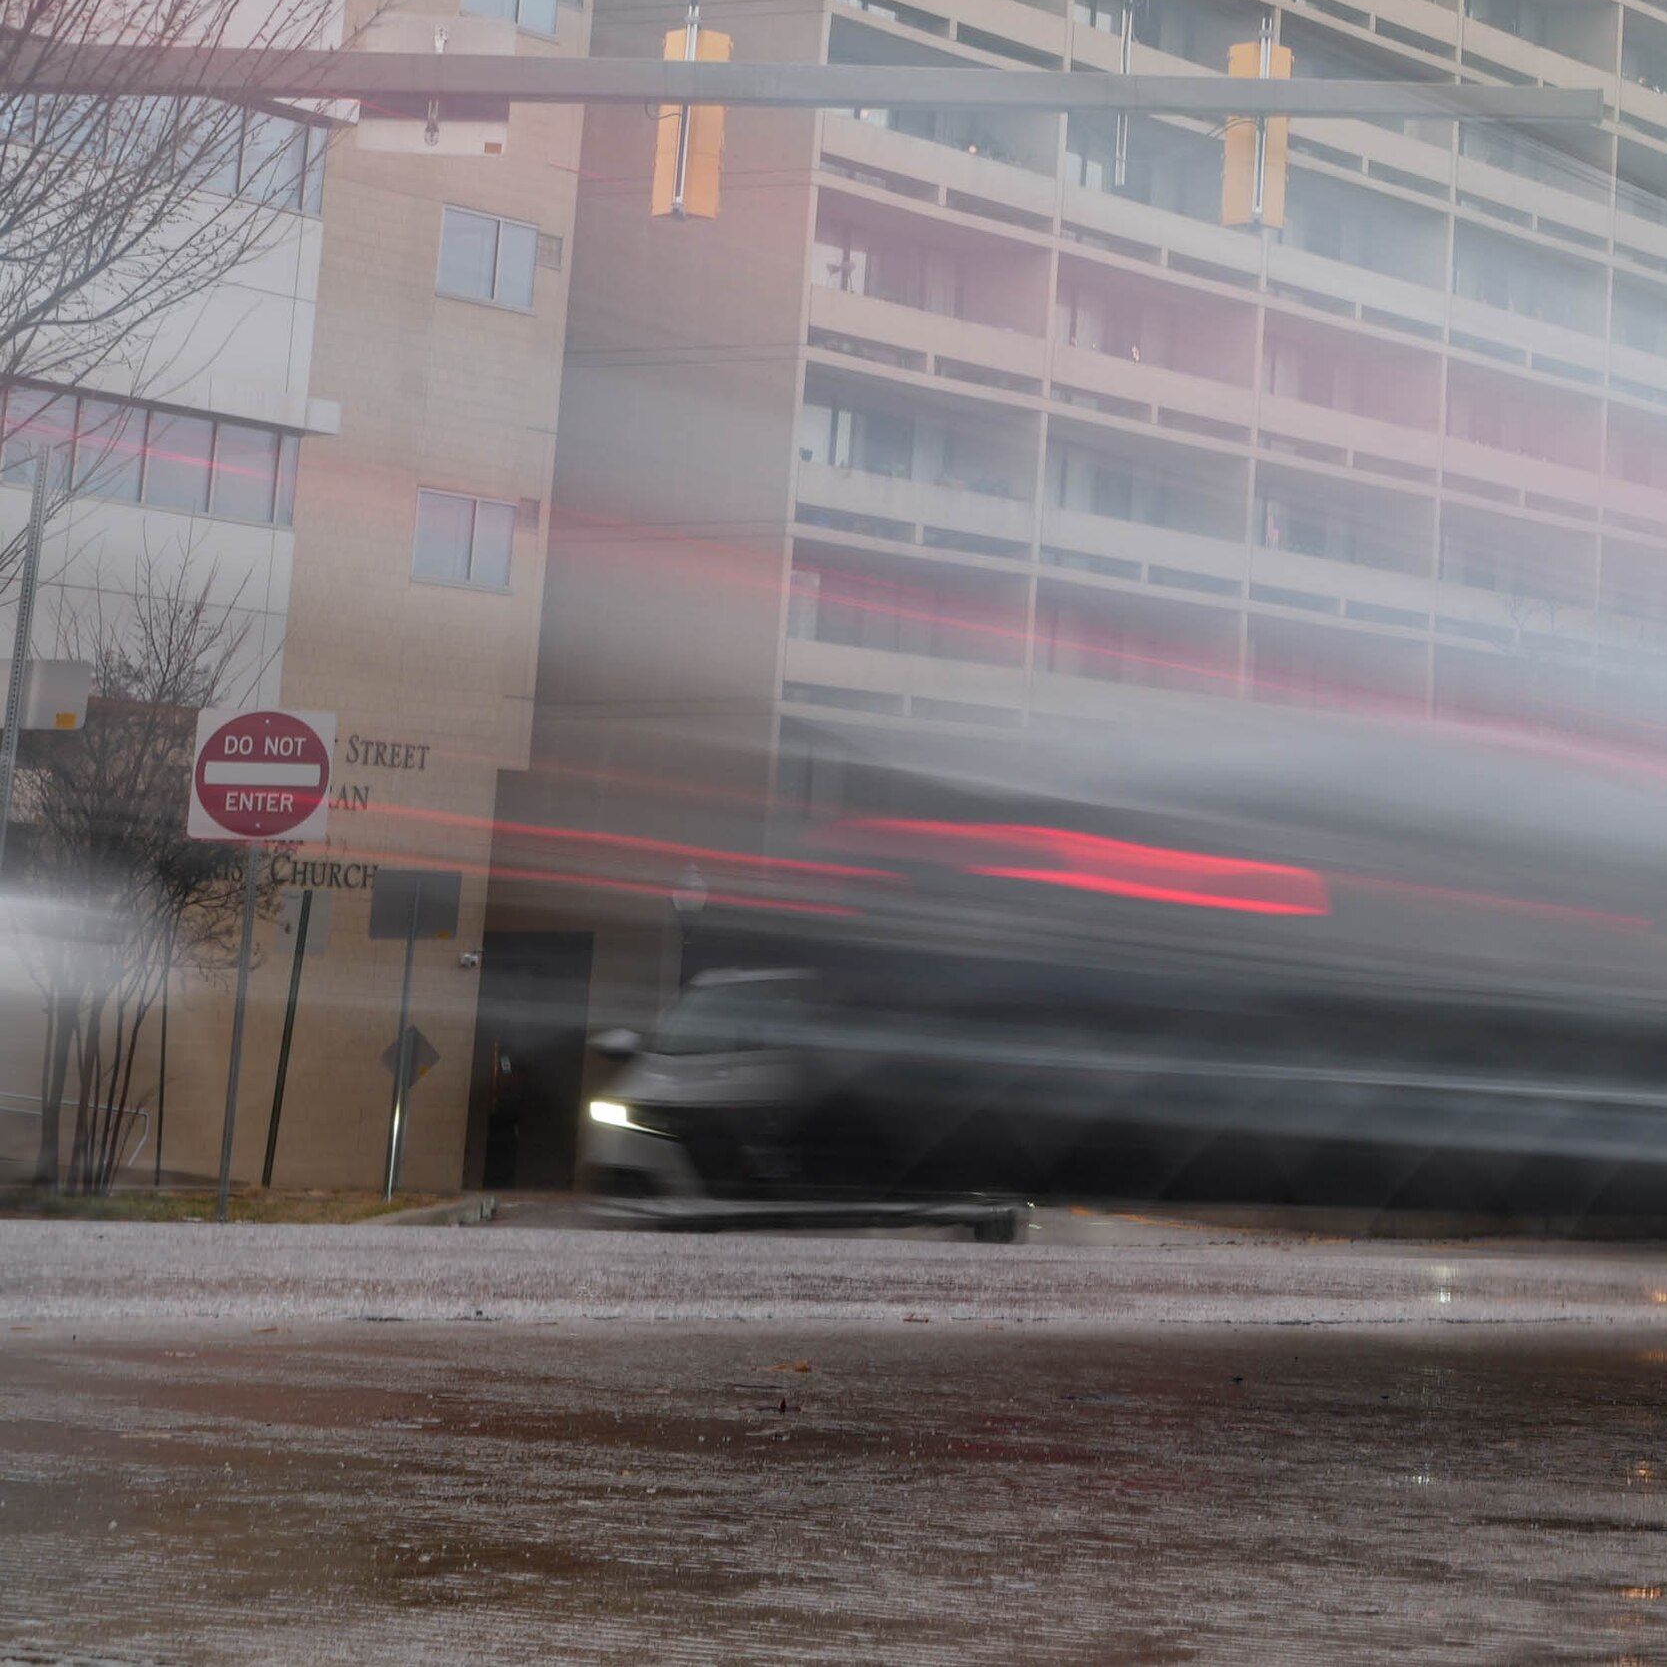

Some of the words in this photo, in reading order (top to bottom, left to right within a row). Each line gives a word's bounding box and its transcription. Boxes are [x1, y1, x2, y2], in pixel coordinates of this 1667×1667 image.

[223, 735, 253, 756] DO
[264, 736, 307, 758] NOT
[345, 734, 430, 770] STREET
[225, 791, 294, 813] ENTER
[270, 854, 379, 889] CHURCH
